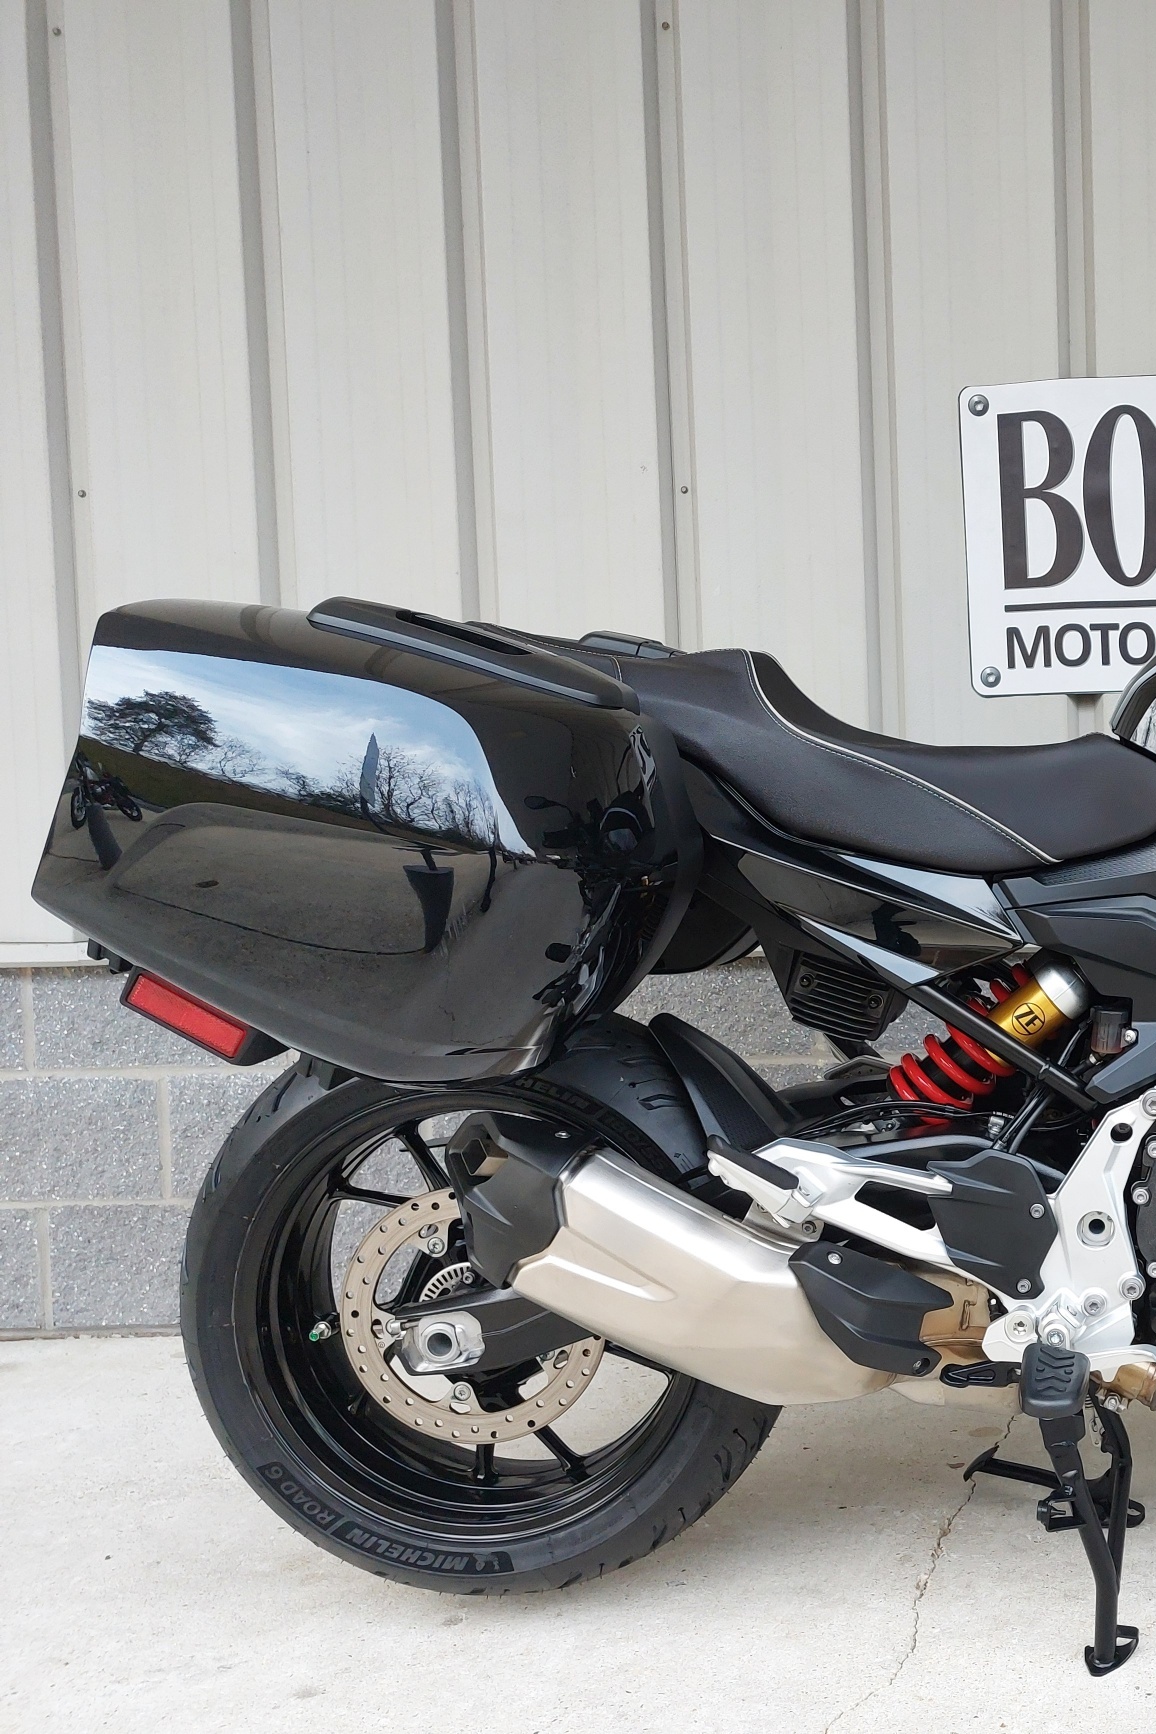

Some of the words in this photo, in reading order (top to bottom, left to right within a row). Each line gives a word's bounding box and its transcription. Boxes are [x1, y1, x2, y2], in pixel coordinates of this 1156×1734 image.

[264, 1463, 283, 1480] 6
[280, 1479, 335, 1525] ROAD
[344, 1527, 469, 1571] MICHELIN
